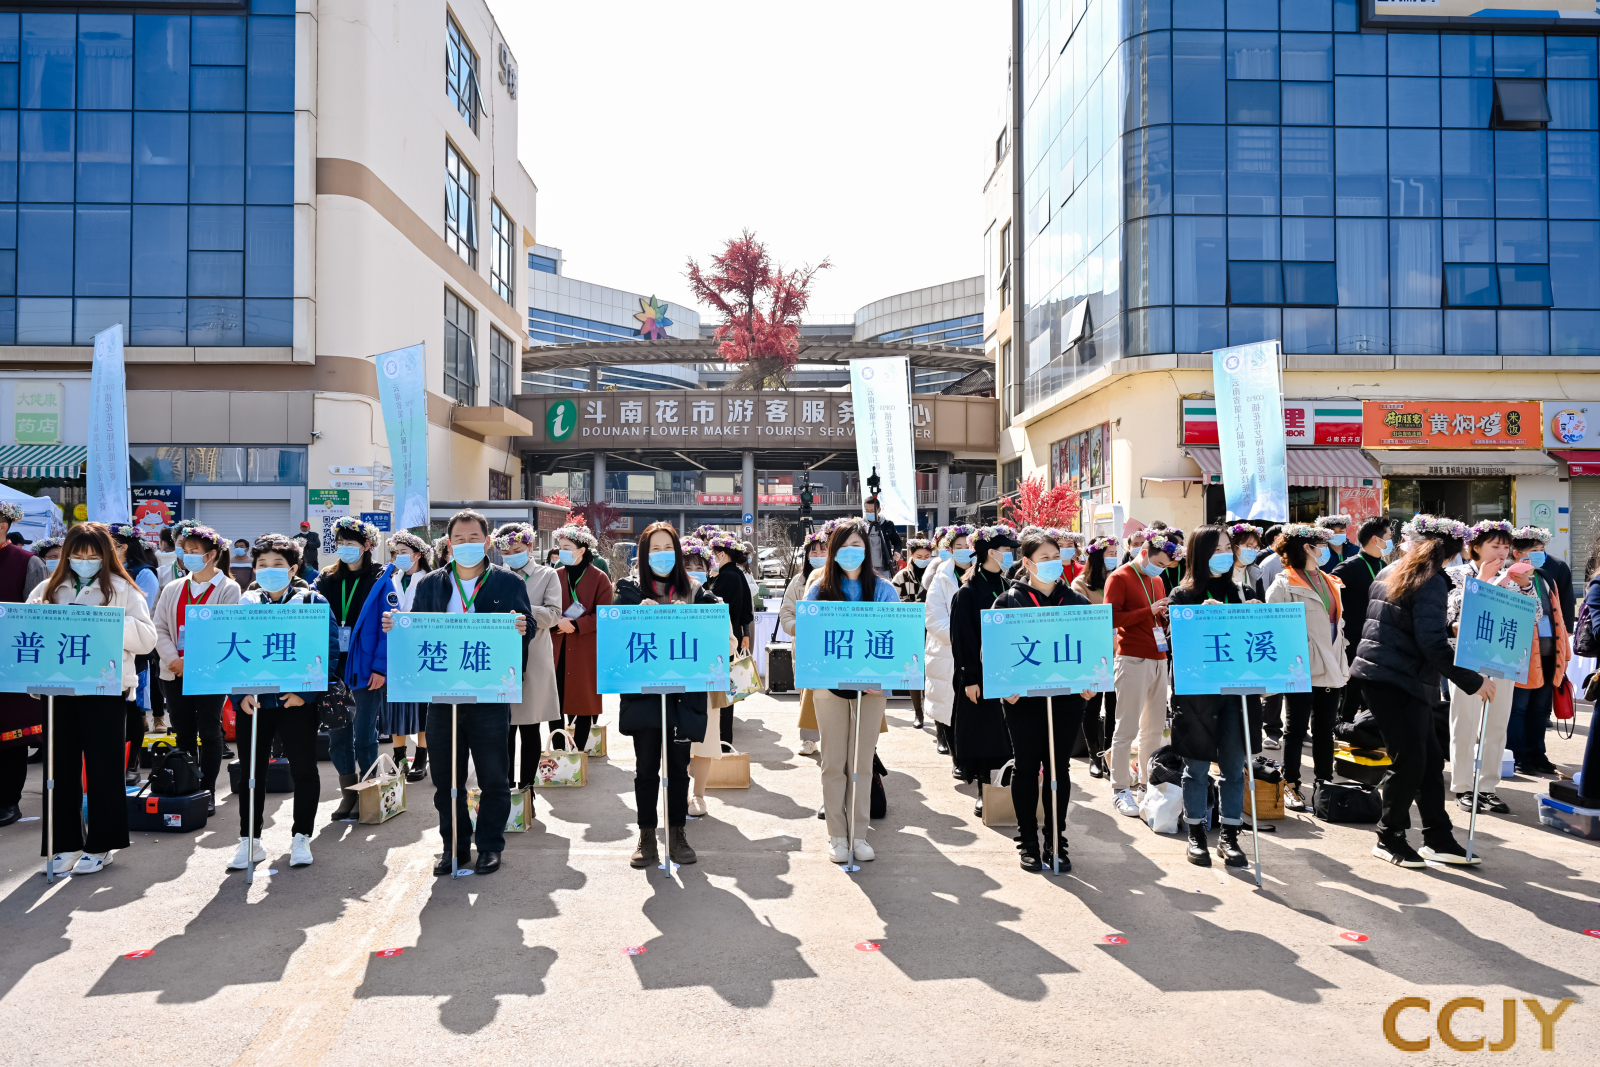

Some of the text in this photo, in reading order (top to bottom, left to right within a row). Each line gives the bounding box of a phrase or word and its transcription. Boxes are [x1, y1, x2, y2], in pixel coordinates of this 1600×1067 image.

[17, 393, 57, 407] 大健康
[585, 399, 931, 427] 斗南花市游客服务心
[17, 418, 57, 433] 药店
[582, 426, 854, 437] DOUNAN FLOWER MAKET TOURIST SERV
[1284, 408, 1305, 428] 里
[1428, 412, 1502, 437] 黄焖鸡
[1508, 412, 1519, 434] 米饭
[824, 628, 895, 660] 昭通
[1476, 610, 1518, 650] 曲靖
[11, 631, 91, 665] 普洱
[216, 632, 297, 664] 大理
[417, 640, 491, 673] 楚雄
[625, 631, 698, 663] 保山
[1010, 633, 1082, 668] 文山
[1202, 630, 1278, 663] 玉溪
